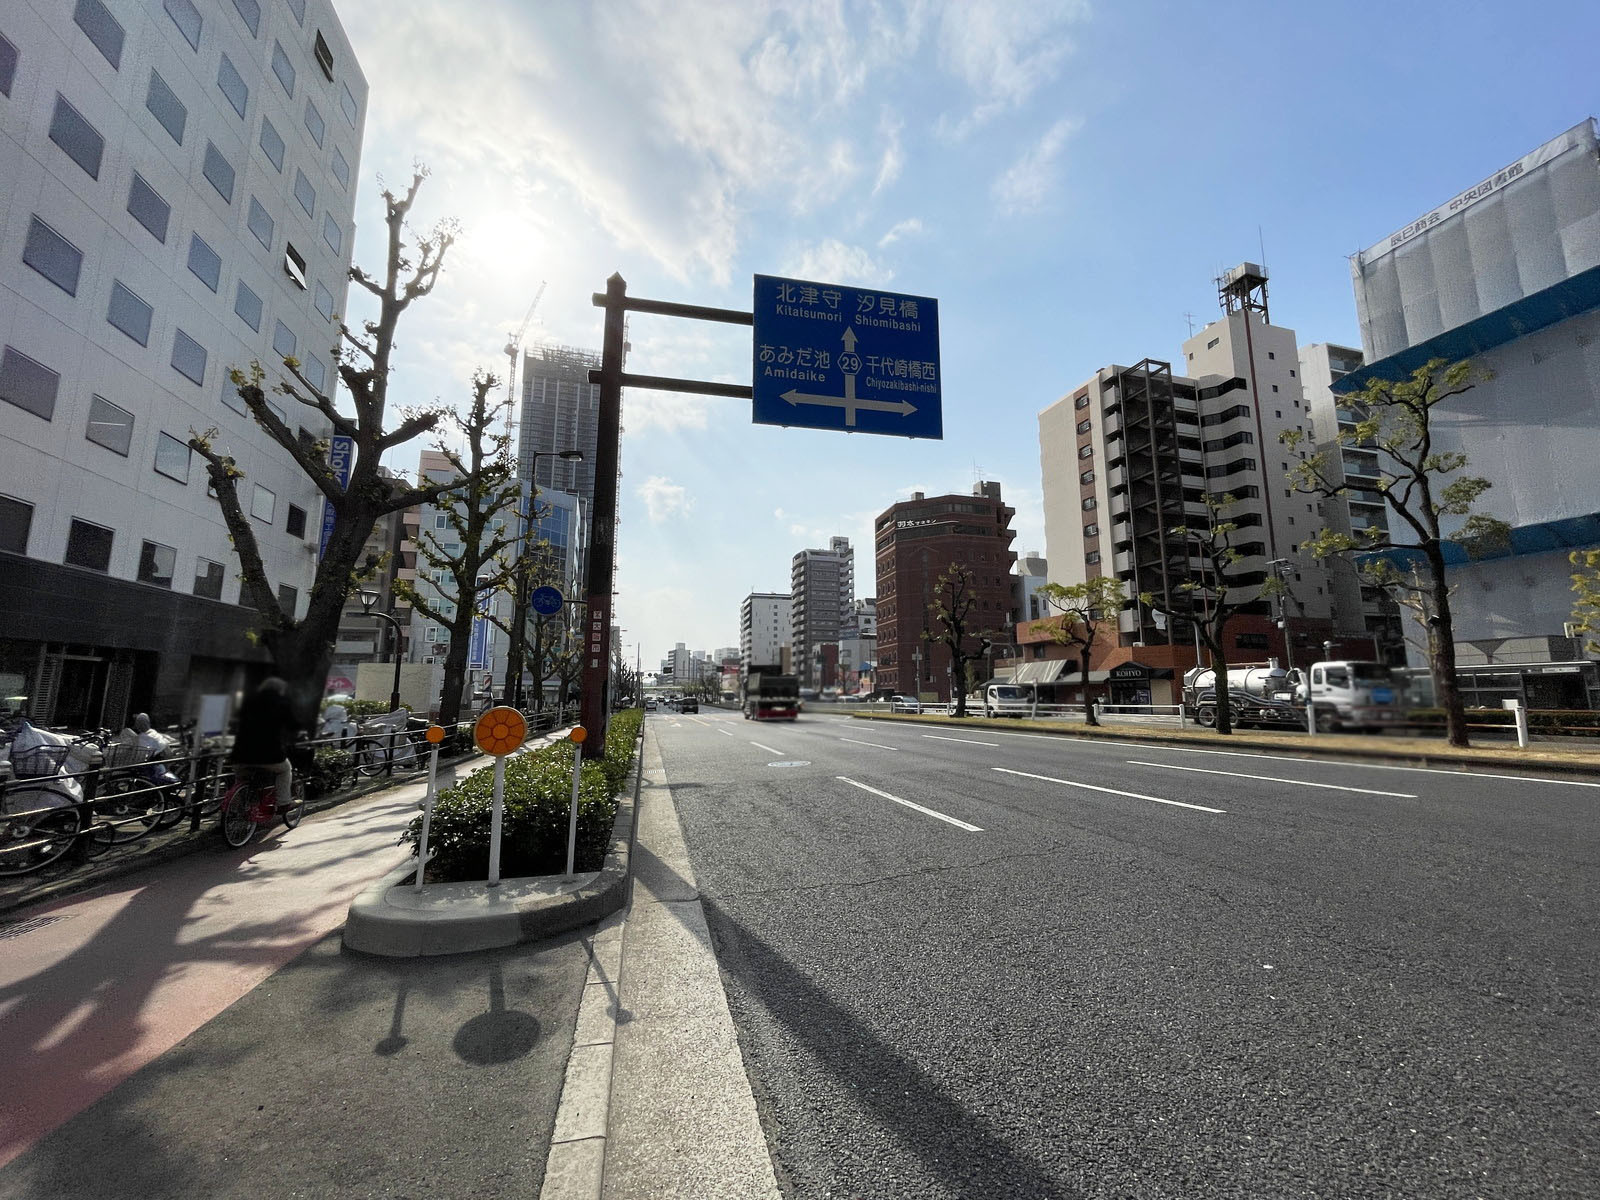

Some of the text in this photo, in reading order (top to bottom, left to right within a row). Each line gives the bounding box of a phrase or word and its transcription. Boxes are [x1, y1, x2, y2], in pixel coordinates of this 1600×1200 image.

[776, 283, 918, 319] 北津守 汐見橋
[776, 305, 921, 332] Kitatsumori Shiomibashi
[760, 344, 830, 369] あみだ池
[842, 357, 858, 371] 29
[866, 355, 936, 380] 千代崎橋西
[764, 366, 826, 382] Amidaike
[866, 377, 937, 394] Chiyozakibashi-nishi
